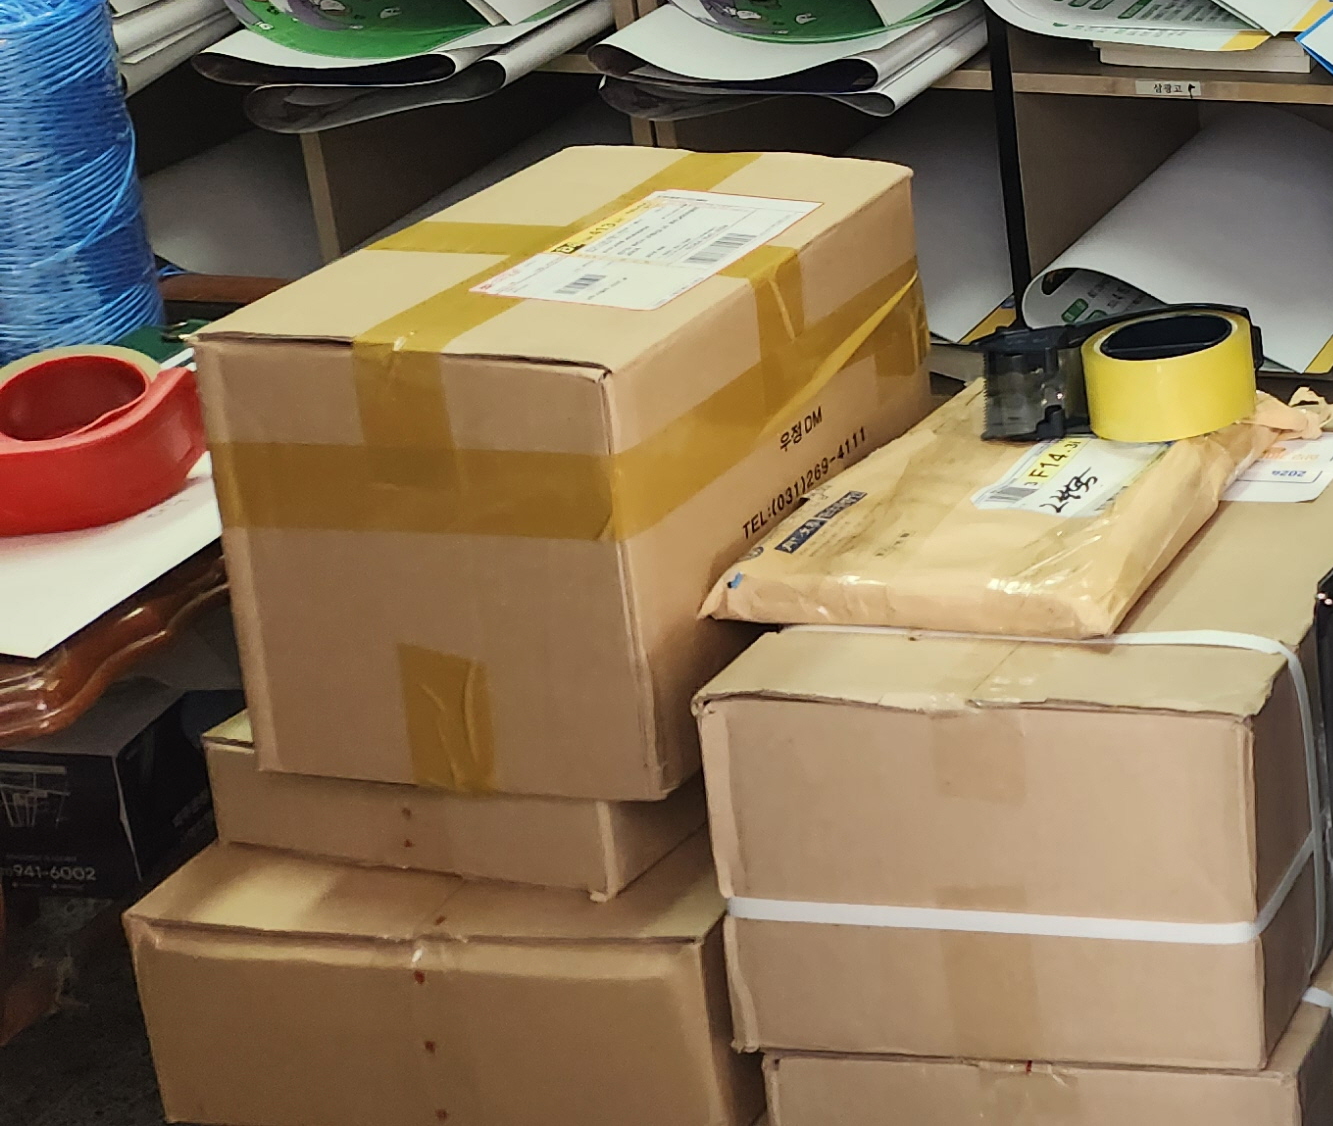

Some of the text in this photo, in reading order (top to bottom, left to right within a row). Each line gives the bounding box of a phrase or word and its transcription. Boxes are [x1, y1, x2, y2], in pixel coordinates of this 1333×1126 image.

[1153, 83, 1184, 94] 삼광고
[780, 406, 823, 452] 우정 DM
